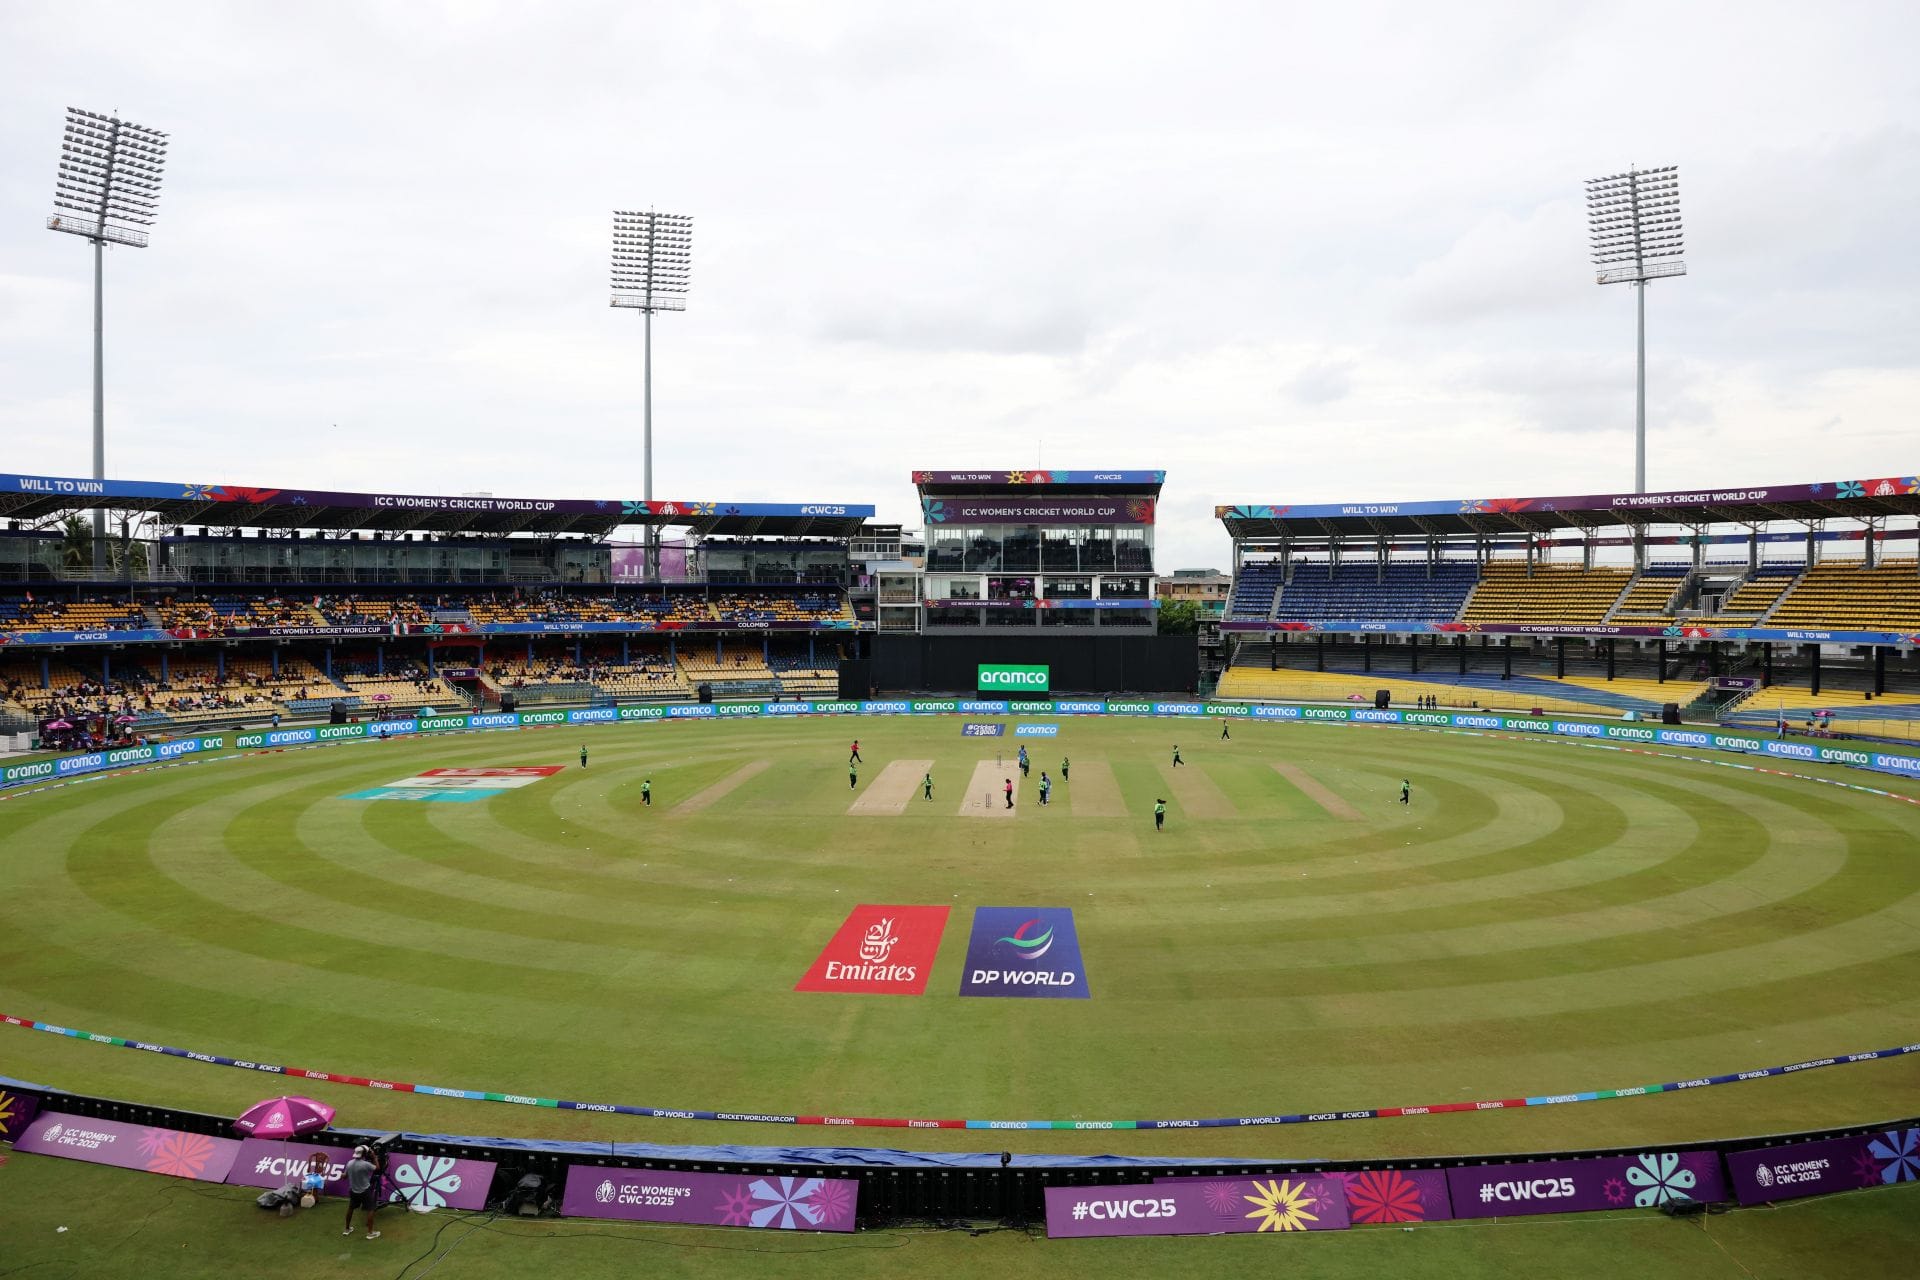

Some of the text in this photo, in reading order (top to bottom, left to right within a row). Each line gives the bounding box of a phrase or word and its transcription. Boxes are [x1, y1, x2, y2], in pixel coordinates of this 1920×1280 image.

[20, 478, 104, 493] WILL TO WIN
[1612, 490, 1768, 506] ICC WOMEN'S CRICKET WORLD CUP
[374, 497, 555, 511] ICC WOMEN'S CRICKET WORLD CUP
[801, 505, 845, 516] #CWC25
[962, 508, 1116, 516] ICC WOMEN'S CRICKET WORLD CUP
[1342, 505, 1398, 515] WILL TO WIN
[74, 632, 108, 641] #CWC25
[1787, 631, 1803, 639] WILL
[980, 669, 1047, 684] aramco
[671, 705, 711, 715] aramco
[720, 704, 760, 714] aramco
[768, 703, 808, 713] aramco
[817, 702, 857, 712] aramco
[865, 701, 906, 711] aramco
[914, 701, 954, 711] aramco
[963, 701, 1003, 711] aramco
[1011, 701, 1052, 711] aramco
[1060, 702, 1101, 712] aramco
[1109, 702, 1150, 712] aramco
[1158, 703, 1199, 713] aramco
[1207, 705, 1248, 716] aramco
[572, 709, 613, 720] aramco
[621, 707, 662, 717] aramco
[1256, 707, 1297, 717] aramco
[1305, 709, 1347, 719] aramco
[1355, 711, 1397, 722] aramco
[472, 715, 515, 726] aramco
[523, 712, 564, 723] aramco
[1406, 713, 1448, 724] aramco
[1456, 715, 1498, 727] aramco
[371, 720, 412, 733] aramco
[421, 717, 463, 729] aramco
[1507, 719, 1549, 731] aramco
[320, 725, 362, 738] aramco
[1016, 726, 1057, 734] aramco
[1558, 722, 1600, 735] aramco
[1609, 726, 1653, 739] aramco
[237, 734, 262, 746] mco
[270, 729, 311, 743] aramco
[1661, 730, 1706, 744] aramco
[1715, 736, 1760, 750] aramco
[1768, 742, 1812, 757] aramco
[109, 748, 152, 763] aramco
[1821, 749, 1868, 763] aramco
[60, 755, 102, 771] aramco
[7, 763, 52, 779] aramco
[825, 961, 917, 982] Emirates
[972, 970, 1075, 986] DP WORLD
[89, 1033, 112, 1043] aramco
[144, 1044, 163, 1053] WORLD
[195, 1053, 215, 1062] WORLD
[234, 1060, 255, 1069] #CWC25
[259, 1064, 280, 1073] #CWC25
[305, 1070, 329, 1080] Emirates
[1748, 1070, 1769, 1079] WORLD
[369, 1080, 393, 1090] Emirates
[1687, 1079, 1710, 1088] WORLD
[433, 1088, 465, 1098] aramco
[1615, 1086, 1646, 1097] aramco
[504, 1095, 537, 1105] aramco
[1546, 1094, 1578, 1104] aramco
[587, 1104, 615, 1112] WORLD
[1476, 1100, 1504, 1110] Emirates
[653, 1110, 694, 1119] DP WORLD
[1342, 1111, 1370, 1119] #CWC25
[1401, 1106, 1430, 1116] Emirates
[717, 1113, 795, 1123] CRICKETWORLDCUP.COM
[824, 1117, 854, 1126] Emirates
[1308, 1113, 1336, 1121] #CWC25
[908, 1120, 939, 1128] Emirates
[990, 1120, 1027, 1129] aramco
[1075, 1120, 1112, 1129] aramco
[1170, 1120, 1199, 1128] WORLD
[64, 1128, 117, 1143] ICC WOMEN'S
[58, 1136, 101, 1149] CWC 2025
[1774, 1159, 1830, 1175] ICC WOMEN'S
[1776, 1170, 1821, 1185] CWC 2025
[620, 1184, 691, 1197] ICC WOMEN'S
[1479, 1177, 1576, 1203] #CWC25
[618, 1195, 675, 1206] CWC 2025
[1072, 1198, 1177, 1220] #CWC25
